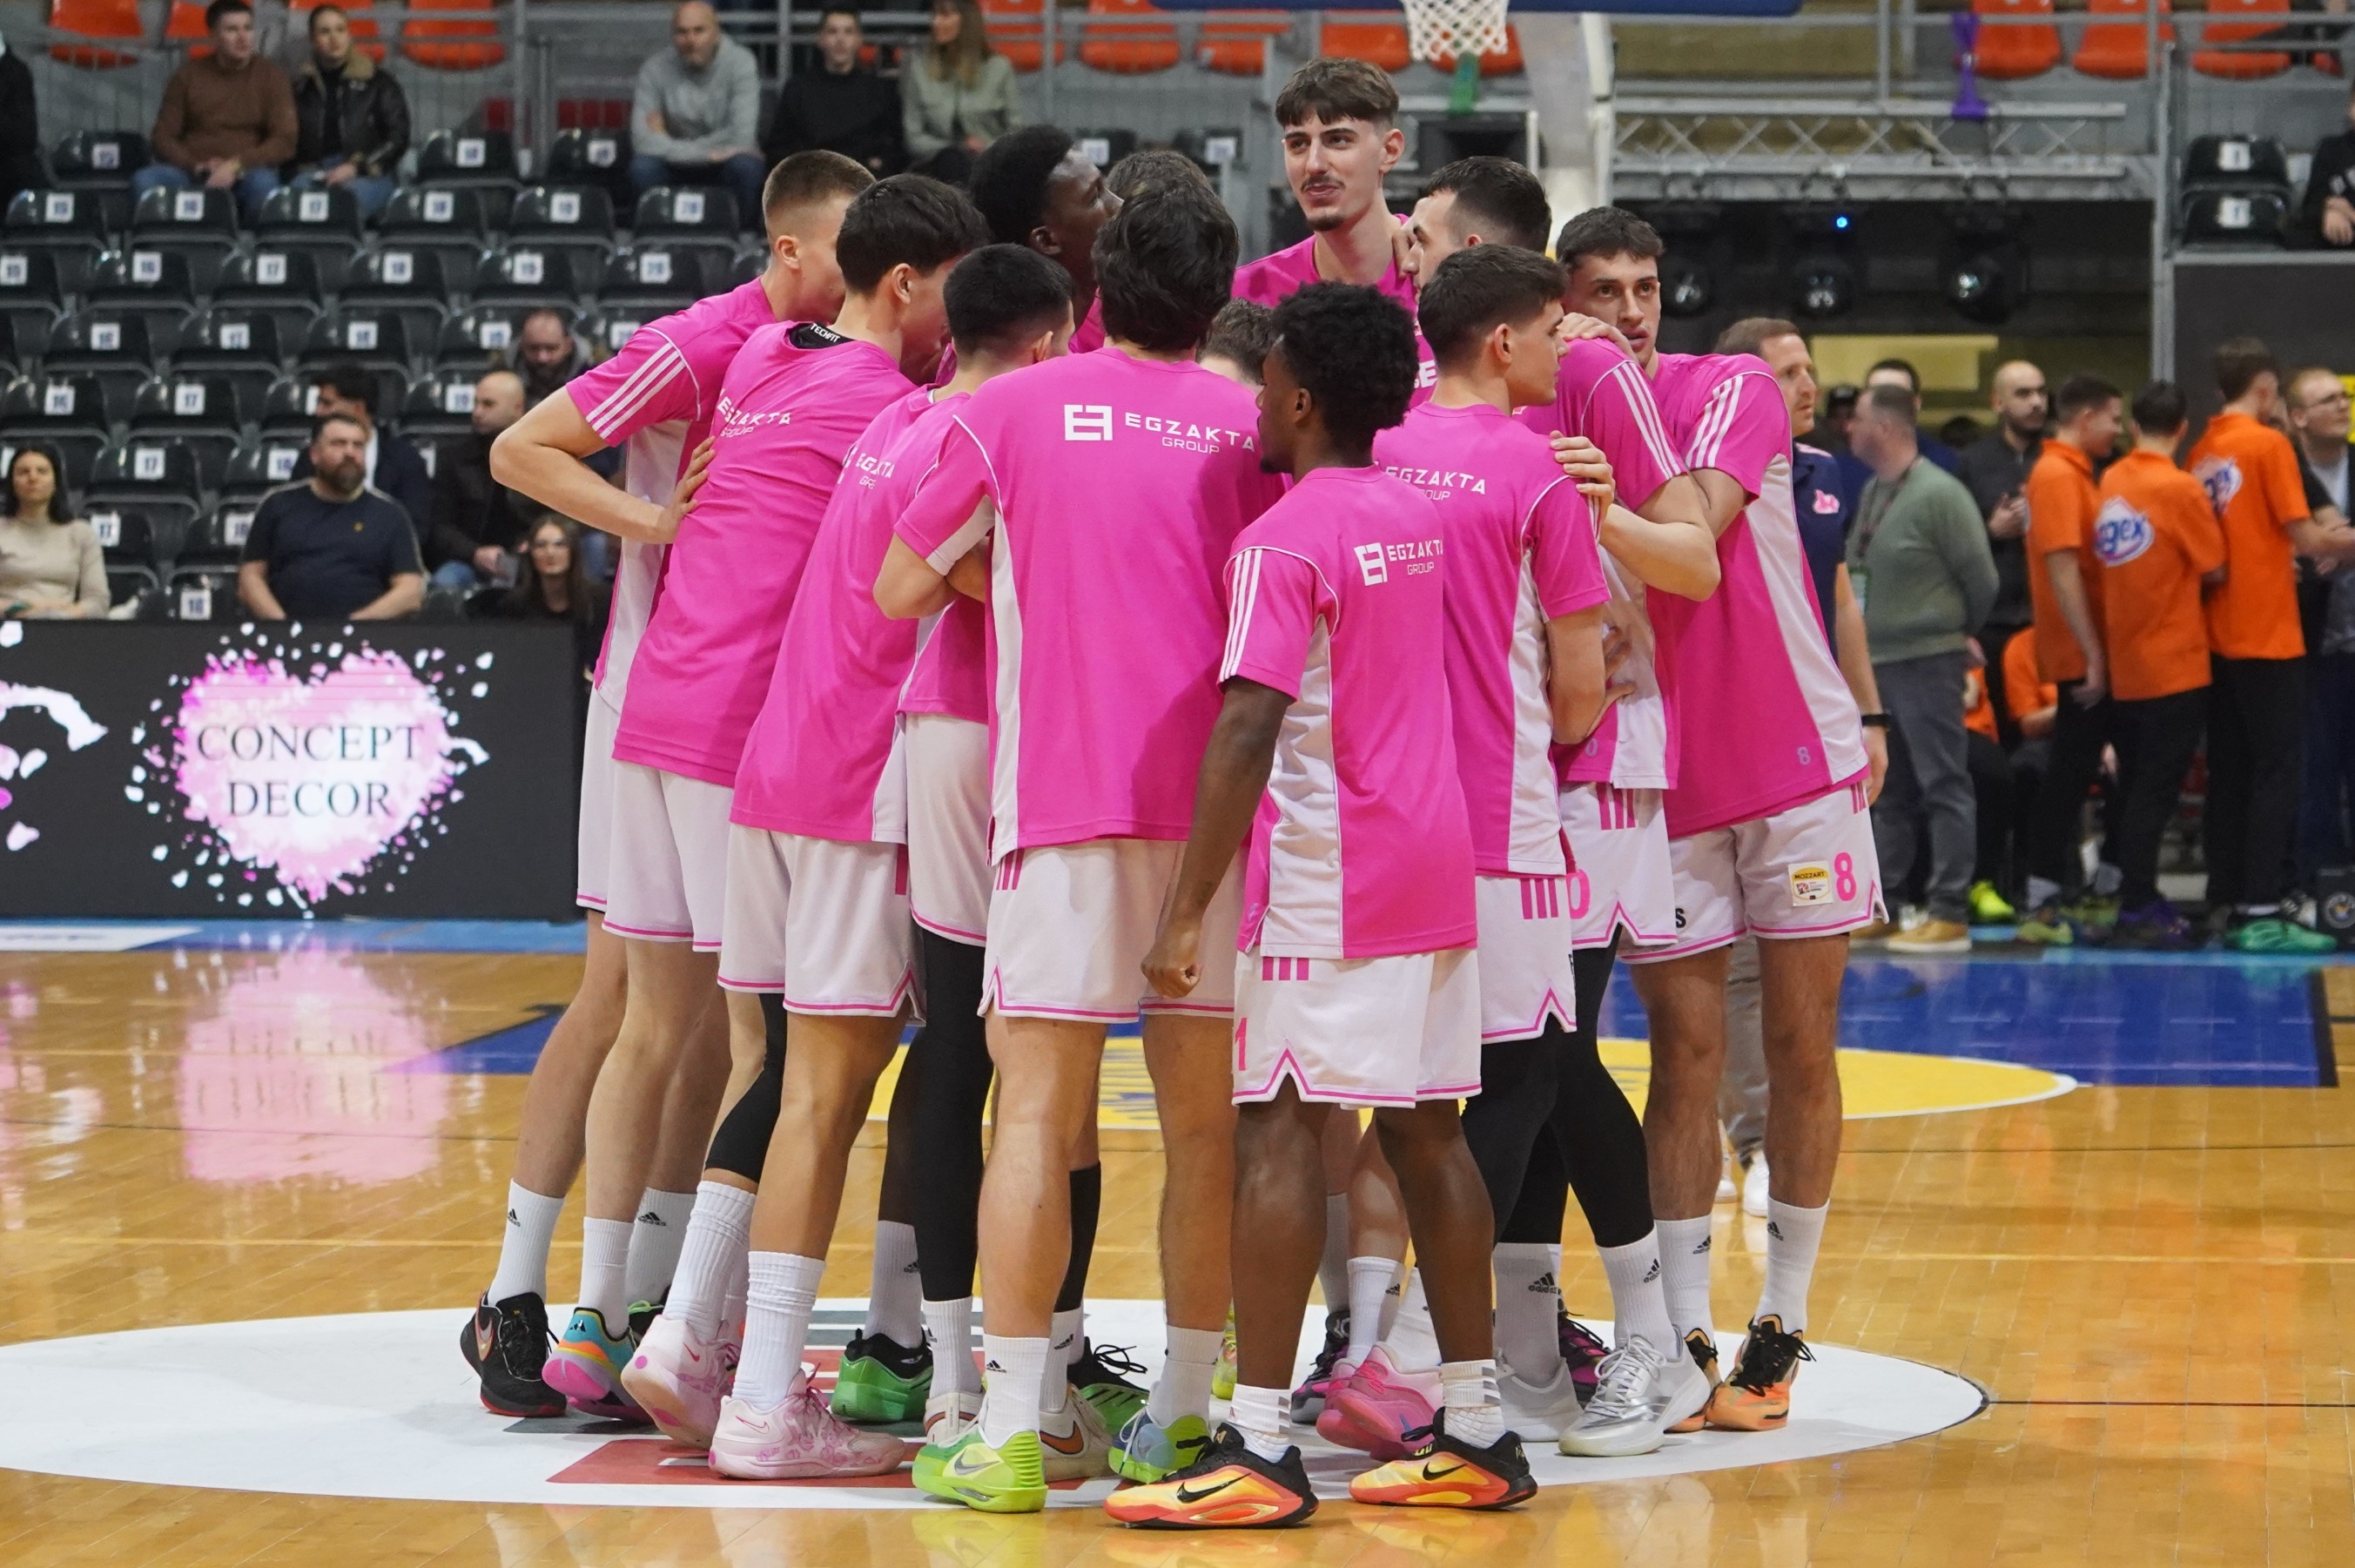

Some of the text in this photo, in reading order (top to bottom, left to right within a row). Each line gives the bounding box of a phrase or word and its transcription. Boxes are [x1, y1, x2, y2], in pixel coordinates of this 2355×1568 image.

[1125, 412, 1255, 453] EGZAKTA
[1161, 436, 1221, 454] GROUP
[1419, 488, 1451, 501] OUP
[1407, 562, 1435, 575] GROUP
[197, 723, 424, 761] CONCEPT
[1797, 746, 1811, 765] 8
[227, 781, 394, 818] DECOR
[1794, 871, 1826, 879] MOZZART
[1834, 851, 1857, 902] 8
